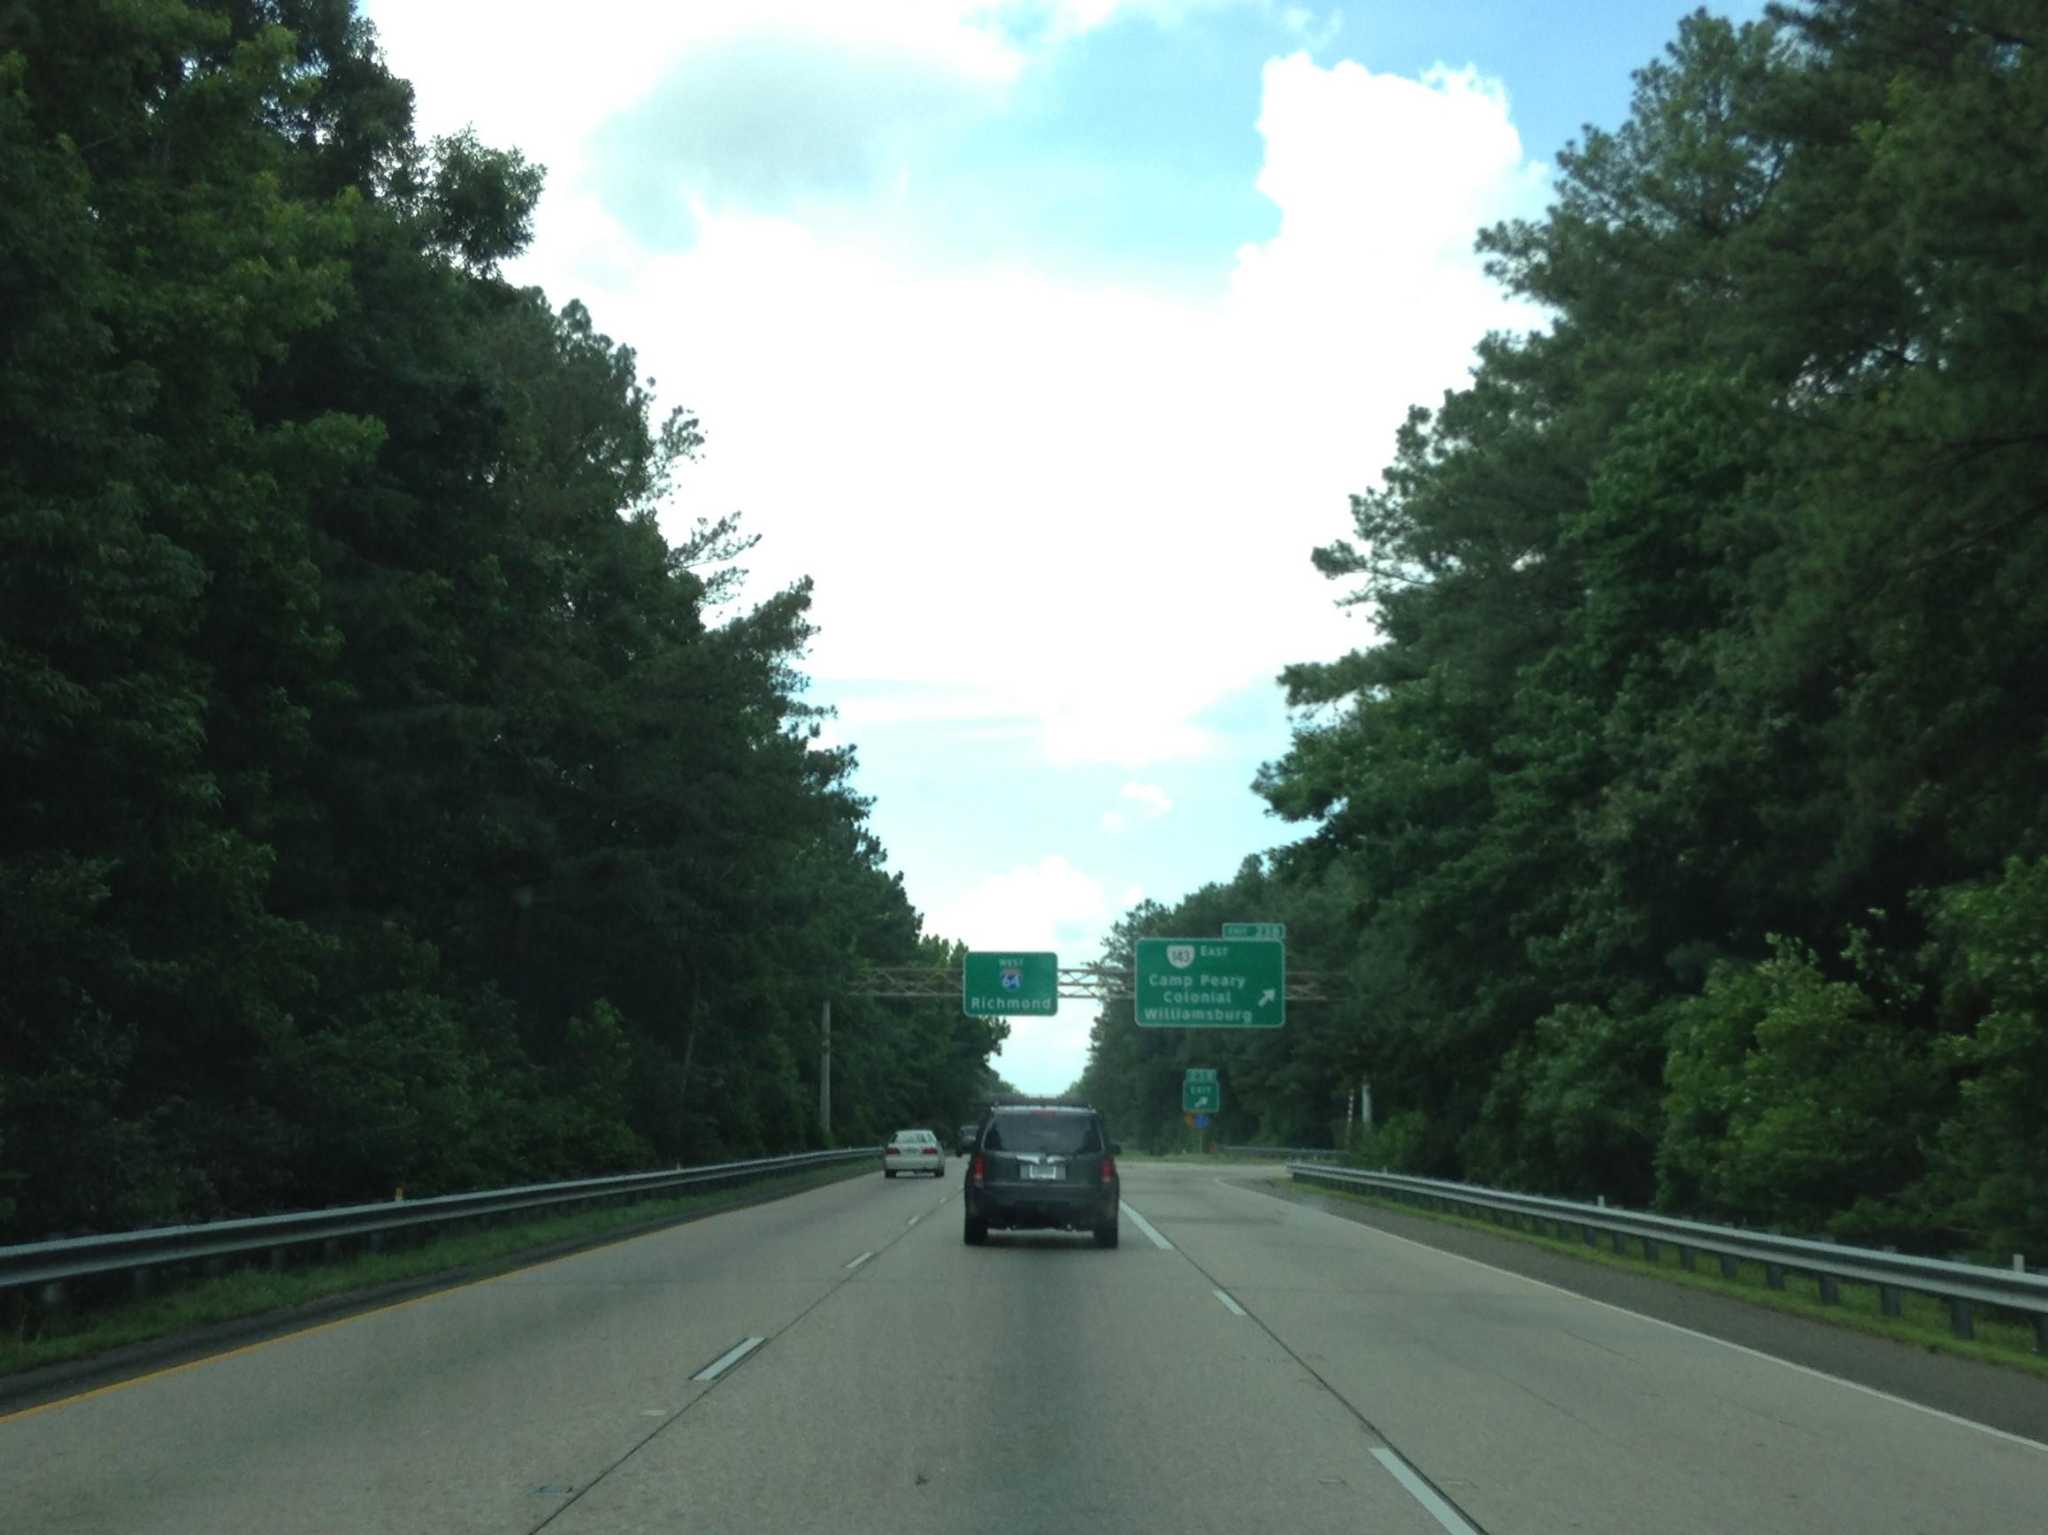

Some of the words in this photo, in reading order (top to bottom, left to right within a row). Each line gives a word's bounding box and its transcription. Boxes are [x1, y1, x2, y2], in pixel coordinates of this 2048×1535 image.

[1149, 974, 1193, 987] Camp
[1200, 974, 1246, 989] Peary
[971, 997, 1051, 1009] Richmond
[1163, 991, 1232, 1004] Colonial
[1144, 1007, 1253, 1023] Williamsburg
